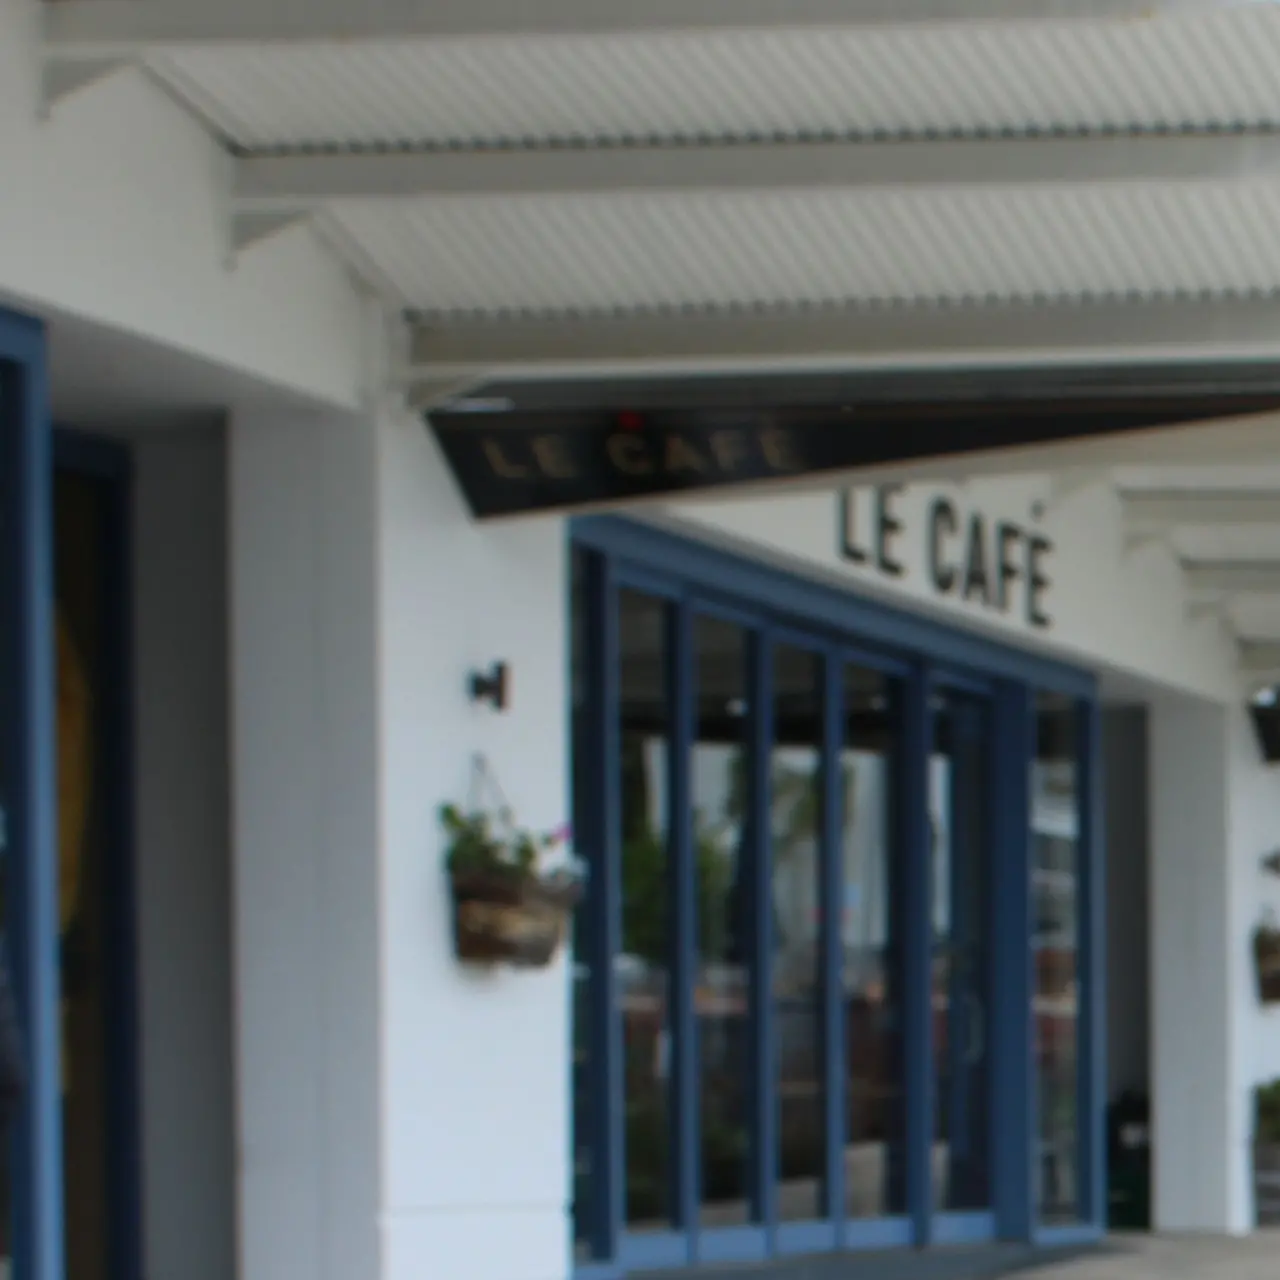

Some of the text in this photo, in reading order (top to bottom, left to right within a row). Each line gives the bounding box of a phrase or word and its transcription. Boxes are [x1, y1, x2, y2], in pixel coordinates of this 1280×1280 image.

[482, 432, 580, 479] LE
[837, 480, 1053, 627] LE CAFÉ
